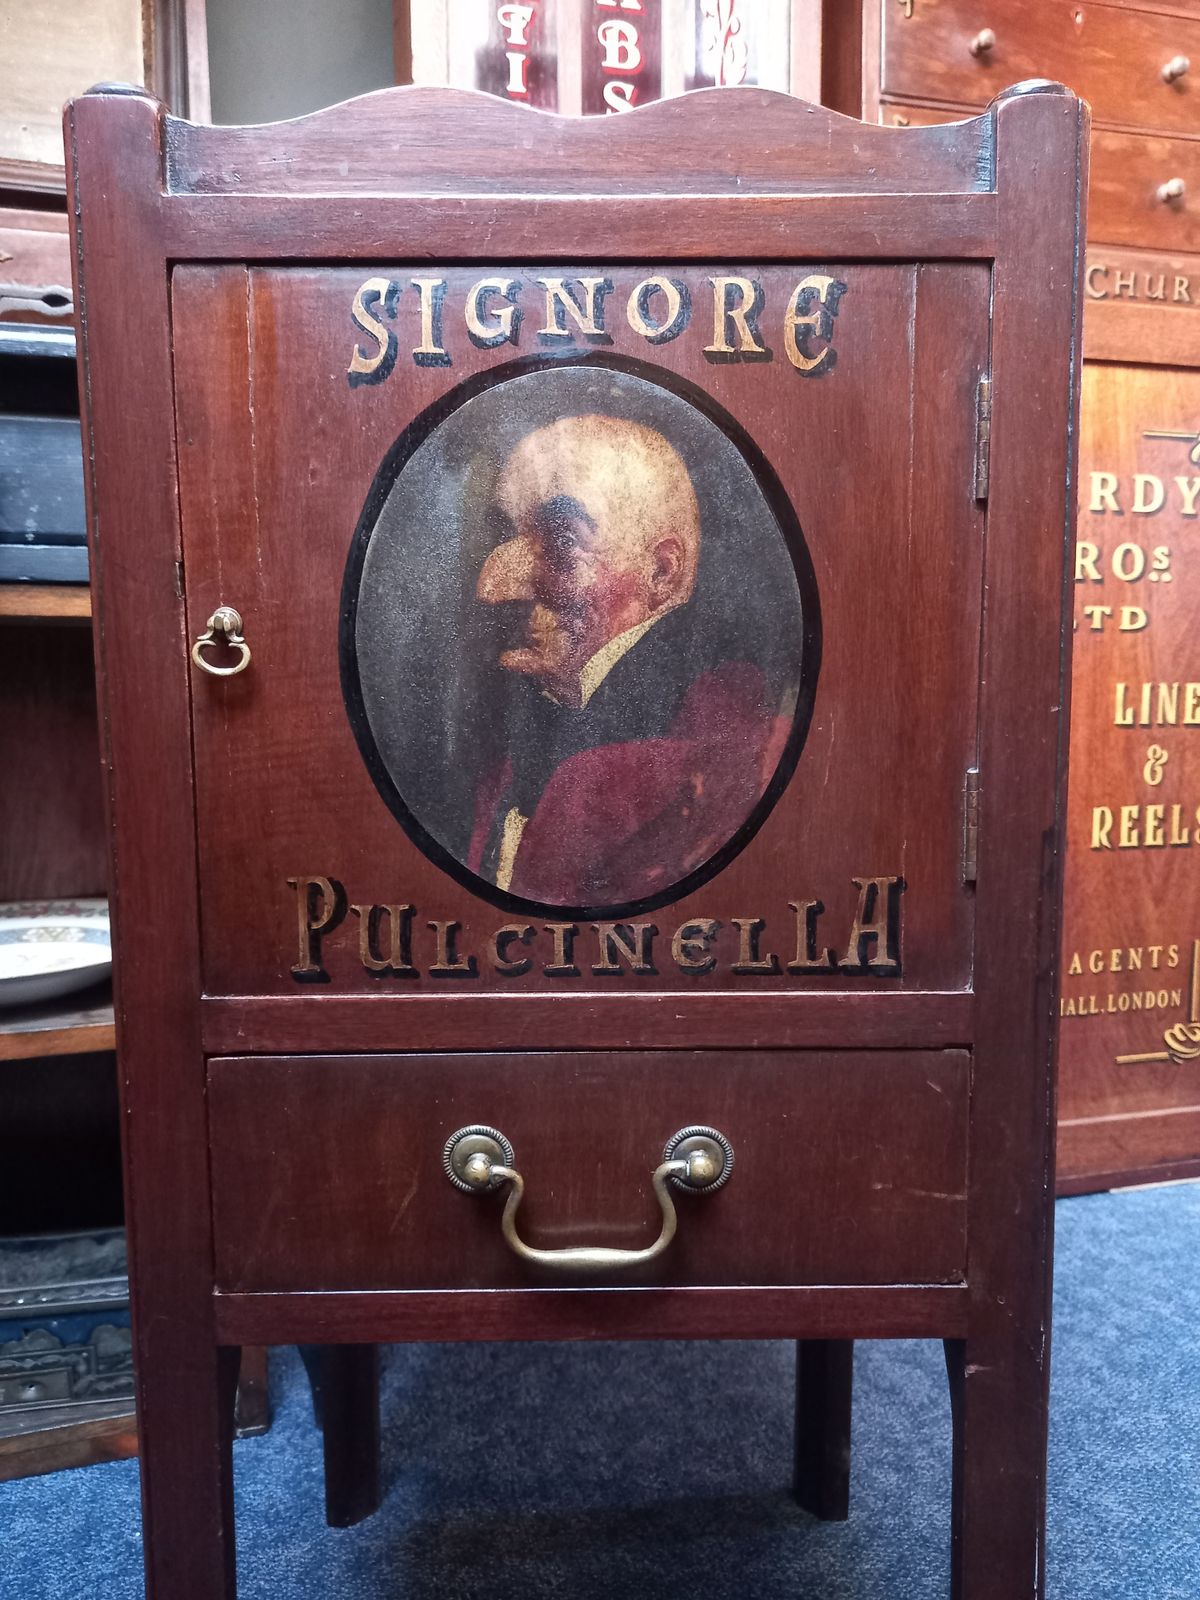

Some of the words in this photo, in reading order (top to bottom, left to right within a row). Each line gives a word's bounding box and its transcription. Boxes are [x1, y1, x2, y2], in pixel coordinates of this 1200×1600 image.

[596, 0, 645, 114] BS
[347, 274, 843, 382] SIGNORE
[1088, 471, 1200, 515] RDY
[1073, 605, 1148, 630] TD
[1143, 744, 1168, 785] &
[286, 875, 904, 977] PULCINELLA
[1068, 945, 1180, 975] AGENTS
[1107, 989, 1181, 1014] LONDON
